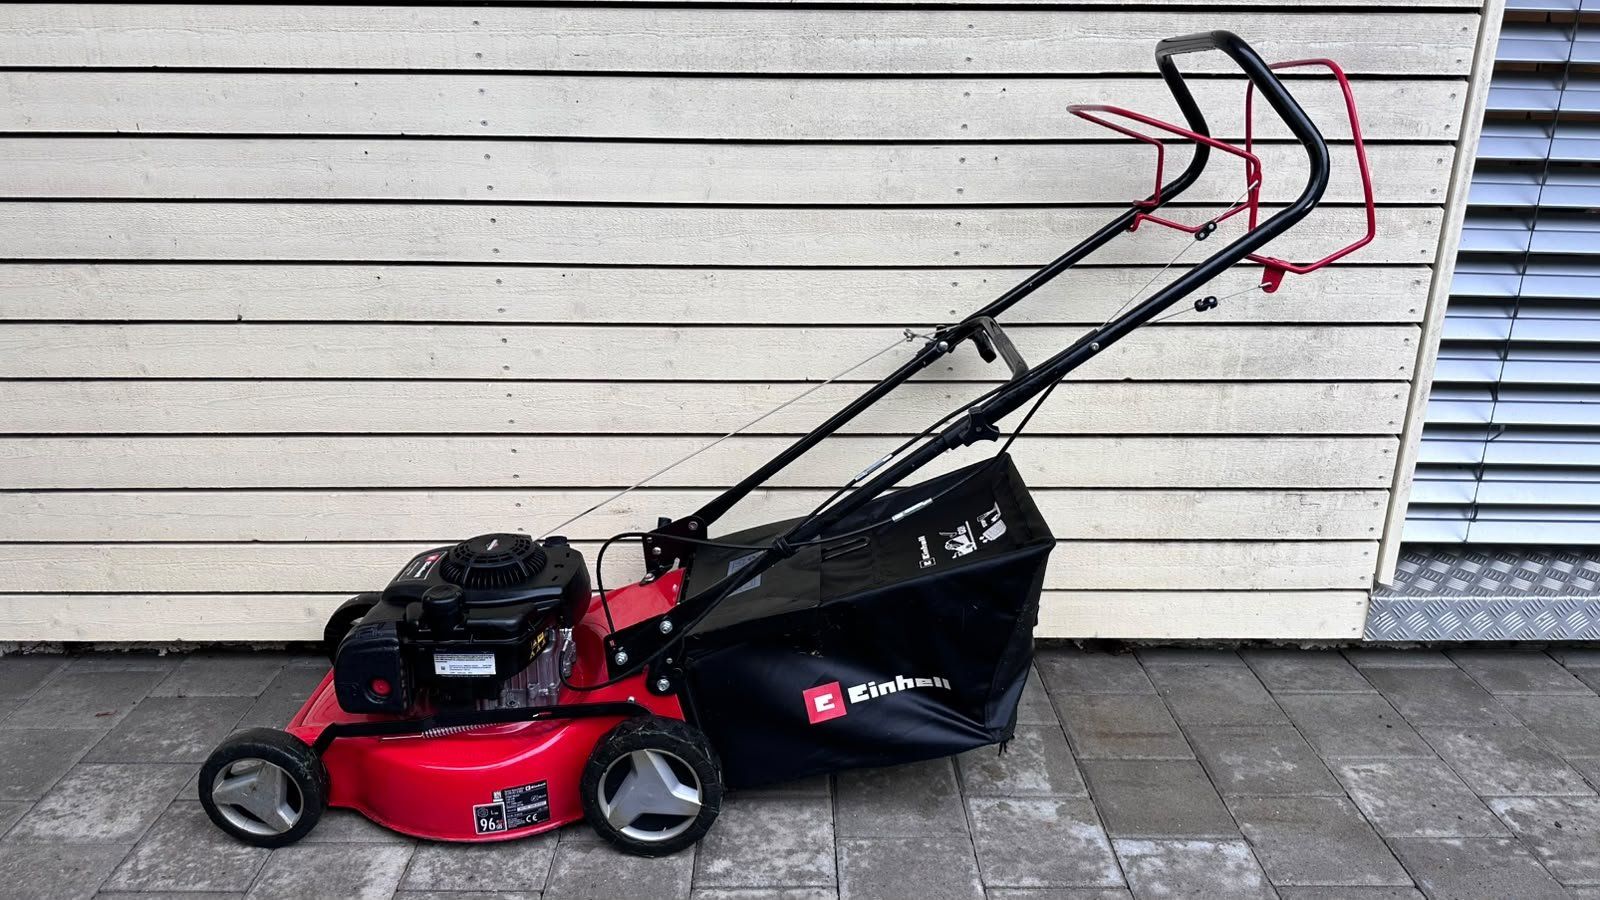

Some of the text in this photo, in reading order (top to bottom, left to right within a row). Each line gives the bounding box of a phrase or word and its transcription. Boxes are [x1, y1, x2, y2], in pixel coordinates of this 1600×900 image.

[814, 675, 951, 712] E Einhell
[480, 817, 496, 831] 96
[526, 813, 538, 823] CE
